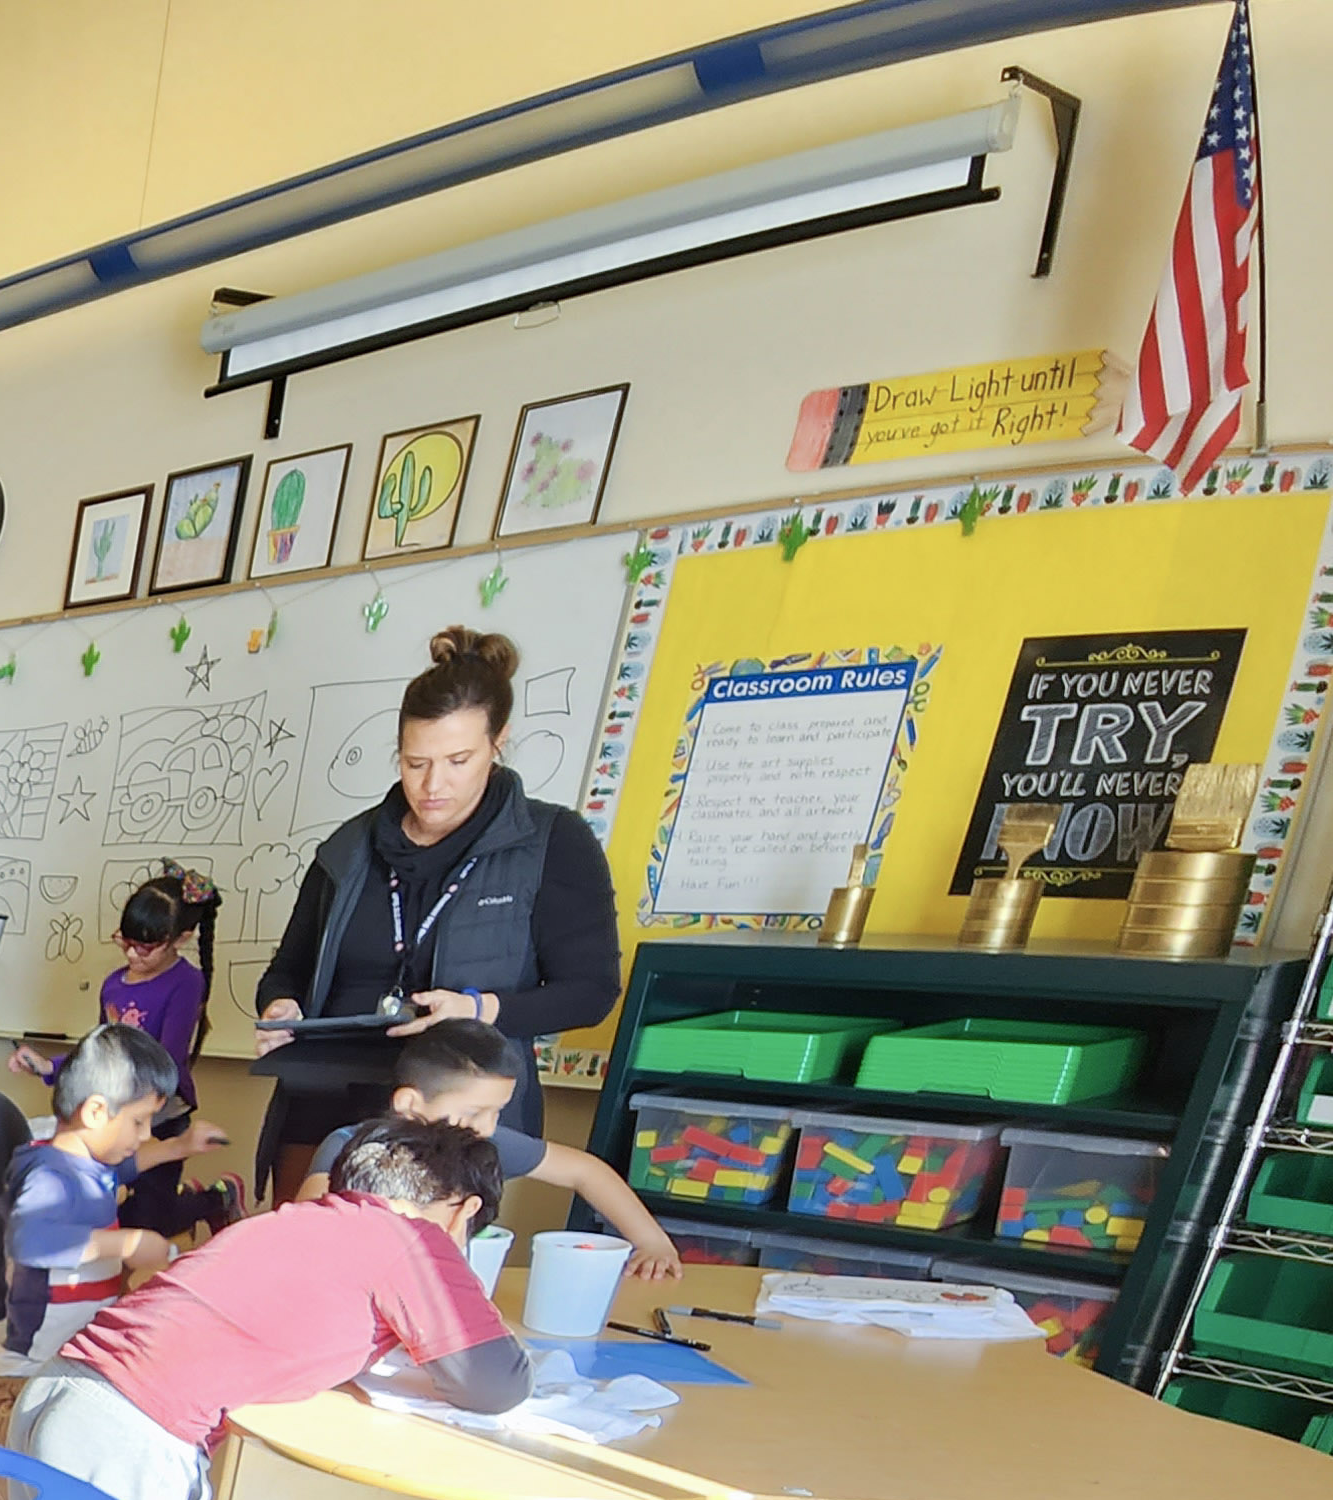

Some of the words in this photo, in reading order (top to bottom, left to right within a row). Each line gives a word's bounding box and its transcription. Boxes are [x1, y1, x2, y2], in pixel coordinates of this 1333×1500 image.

[874, 386, 937, 412] Draw
[950, 368, 1012, 412] Light
[1020, 358, 1077, 392] until
[924, 414, 960, 448] got
[969, 414, 986, 430] it
[992, 402, 1068, 445] Right!
[713, 675, 833, 698] Classroom
[841, 669, 907, 687] Rules
[1027, 673, 1056, 700] IF
[1061, 670, 1119, 698] YOU
[1122, 669, 1213, 698] NEVER
[713, 723, 742, 735] Come
[750, 722, 762, 731] to
[768, 720, 799, 730] class
[808, 717, 855, 731] prepared
[864, 716, 888, 726] and
[1020, 700, 1207, 769] TRY,
[706, 734, 738, 748] ready
[747, 734, 760, 744] to
[766, 732, 795, 743] learn
[799, 731, 820, 742] and
[826, 728, 892, 742] participate
[706, 761, 734, 770] Use
[738, 759, 754, 769] the
[761, 758, 781, 768] art
[788, 756, 835, 770] supplies
[706, 772, 750, 786] properly
[760, 771, 781, 782] and
[822, 766, 871, 780] respect
[1001, 770, 1087, 797] YOU'LL
[1095, 771, 1184, 797] NEVER
[696, 795, 742, 809] Respect
[749, 794, 766, 805] the
[833, 794, 859, 806] your
[759, 807, 781, 817] and
[785, 806, 800, 816] all
[805, 805, 854, 816] artwork
[688, 832, 720, 843] Raise
[761, 830, 789, 841] hand
[797, 830, 821, 841] and
[680, 878, 709, 890] Have
